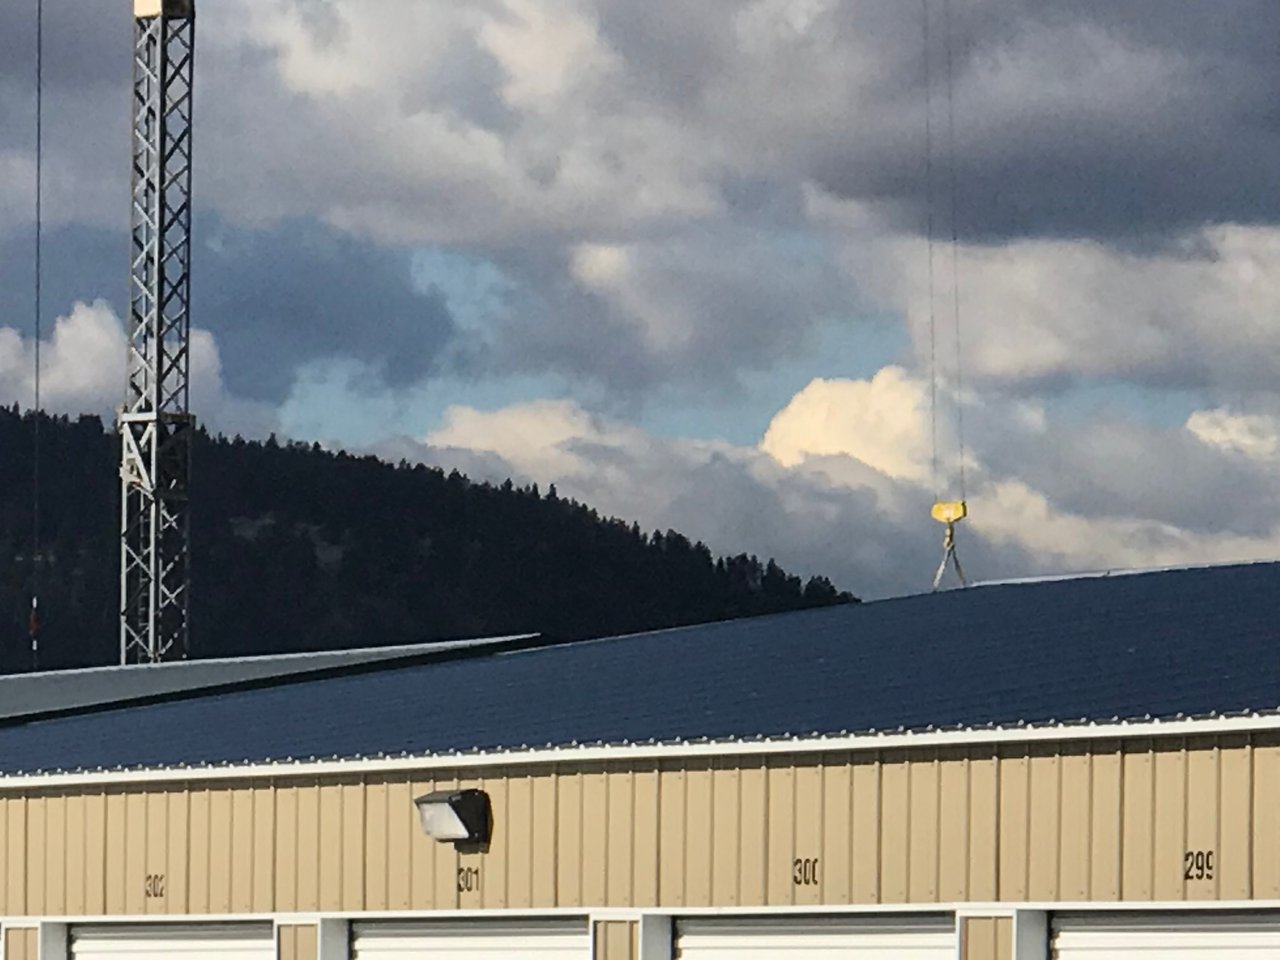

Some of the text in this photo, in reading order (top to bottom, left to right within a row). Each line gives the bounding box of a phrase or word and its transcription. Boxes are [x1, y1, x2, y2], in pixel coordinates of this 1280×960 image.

[793, 858, 818, 885] 300
[1184, 850, 1213, 880] 299
[458, 867, 479, 892] 301
